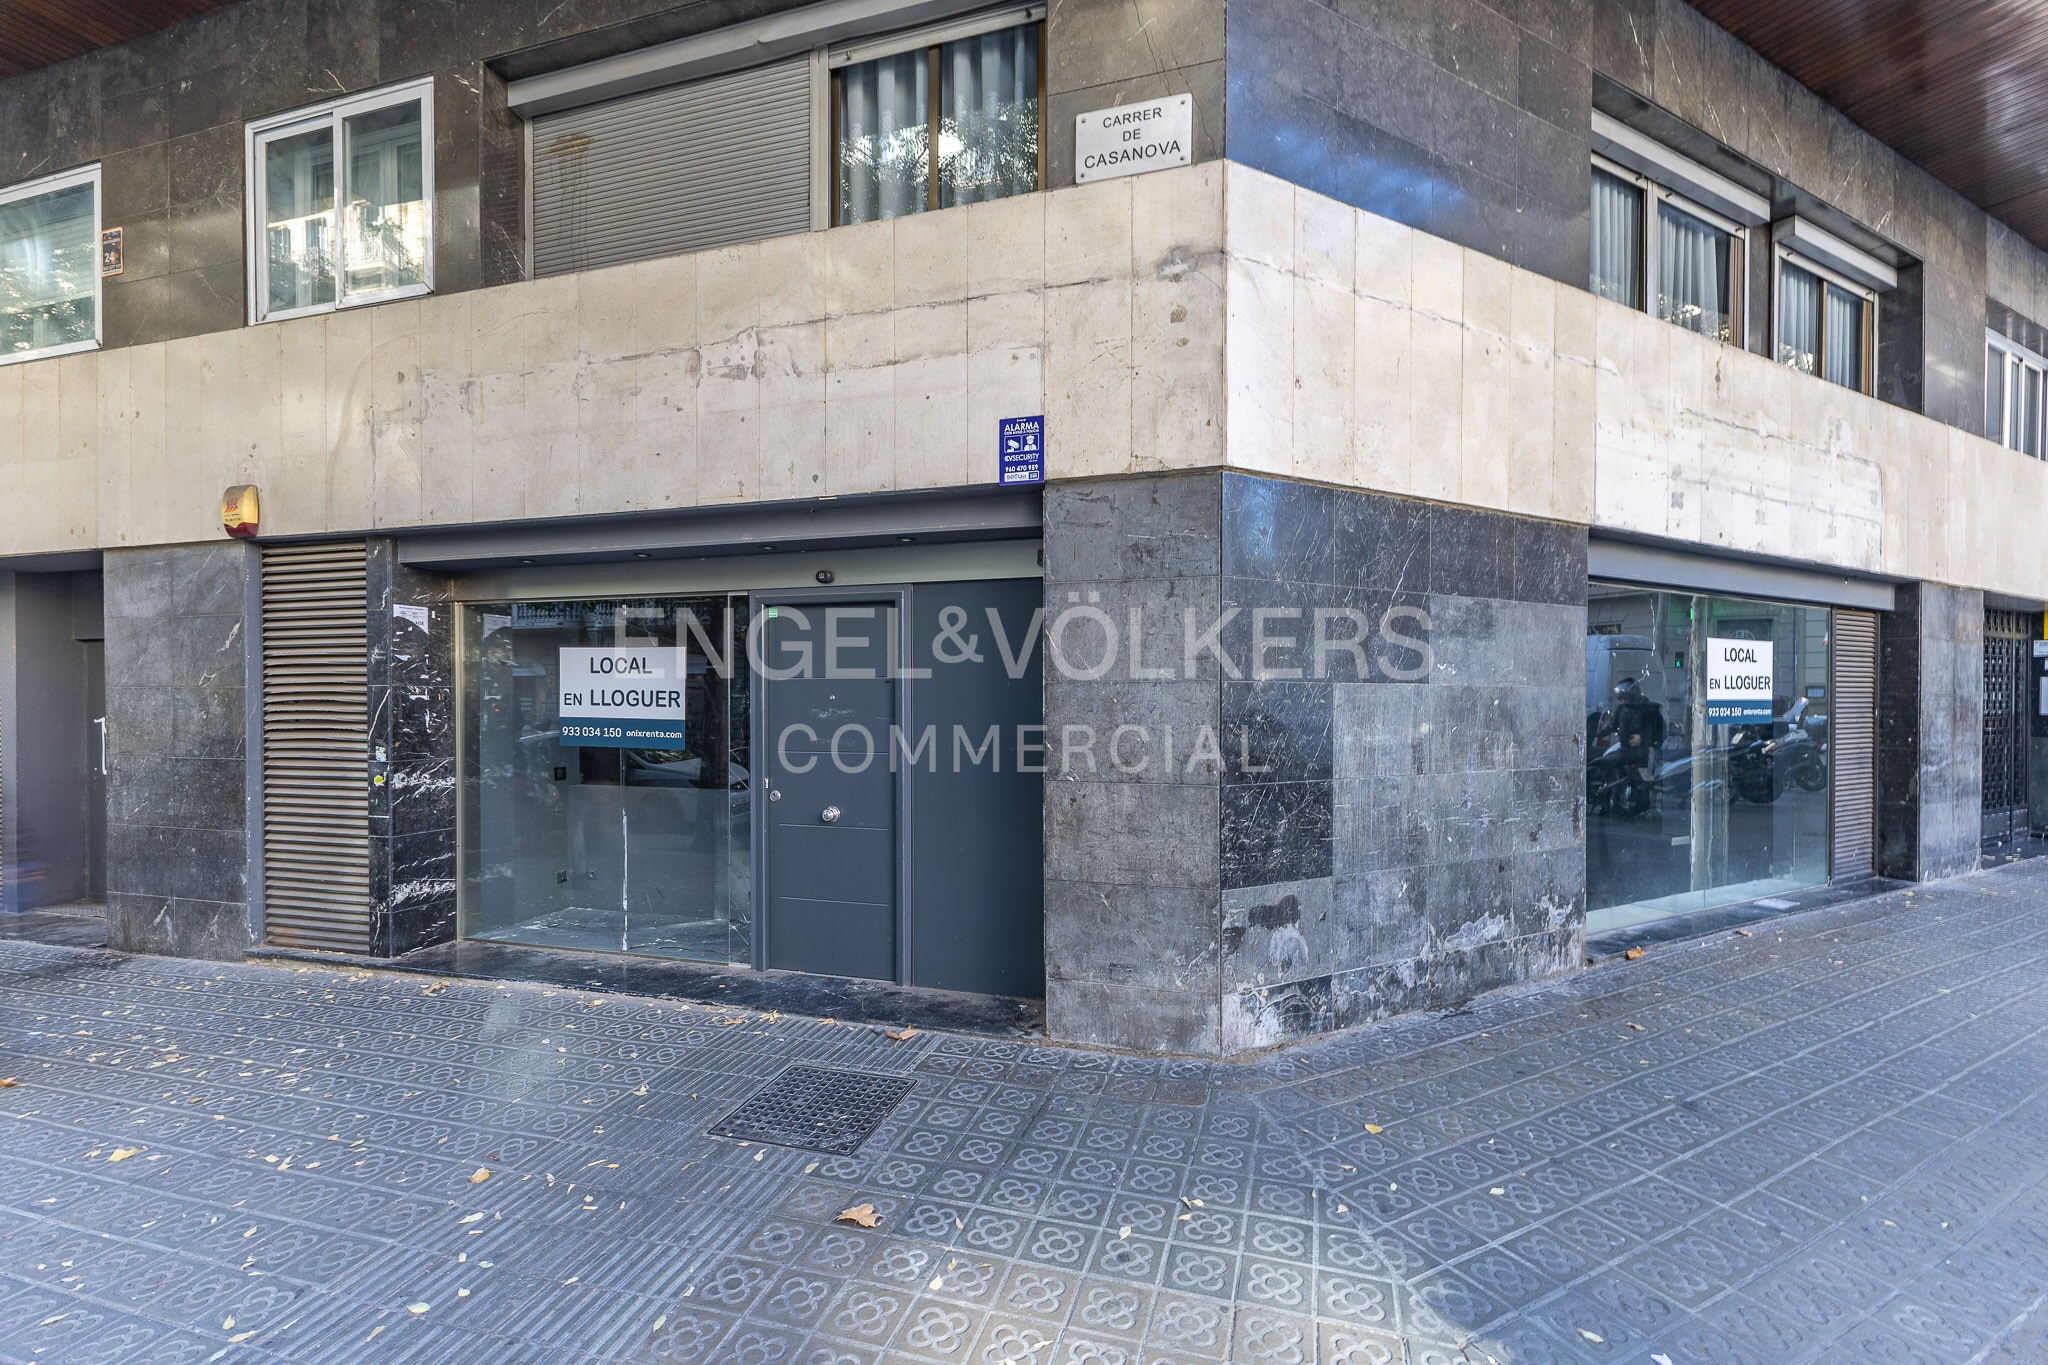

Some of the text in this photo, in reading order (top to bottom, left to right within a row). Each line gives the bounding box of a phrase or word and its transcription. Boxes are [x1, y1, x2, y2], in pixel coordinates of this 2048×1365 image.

[1102, 107, 1162, 128] CARRER
[1122, 128, 1141, 142] DE
[1084, 140, 1181, 169] CASANOVA
[1004, 422, 1040, 431] ALARMA
[1724, 647, 1757, 663] LOCAL
[590, 657, 653, 674] LOCAL
[1709, 675, 1771, 690] EN LLOGUER
[564, 689, 681, 708] EN LLOGUER
[1708, 707, 1719, 717] 933
[1720, 707, 1730, 717] 034
[1731, 707, 1742, 717] 150
[562, 726, 683, 739] 933 034 150 onixrenta.com
